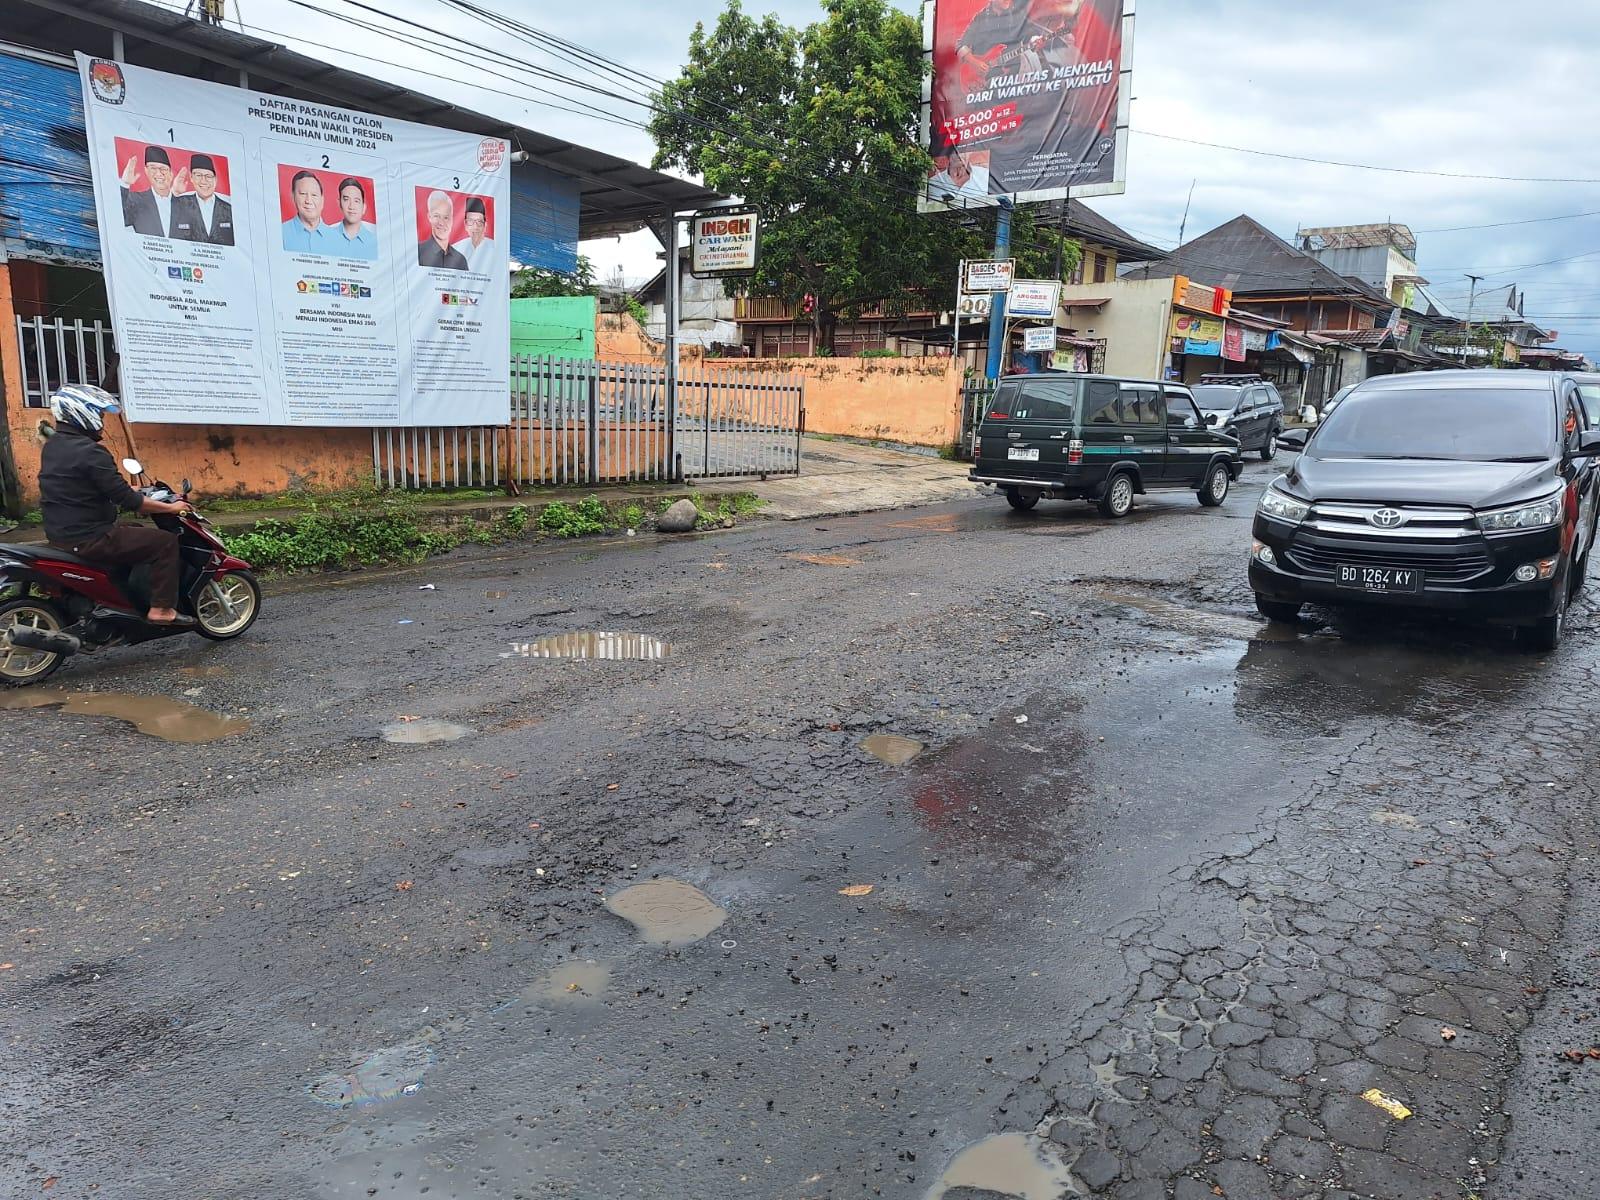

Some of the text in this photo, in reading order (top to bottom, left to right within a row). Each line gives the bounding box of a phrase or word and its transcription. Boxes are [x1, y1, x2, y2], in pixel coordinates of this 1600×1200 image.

[990, 60, 1113, 89] KUALITAS MENYALA
[966, 72, 1112, 104] DARI WAKTU KE WAKTU
[260, 98, 382, 129] DAFTAR PASANGAN CALON
[248, 108, 393, 142] PRESIDEN DAN WAKIL PRESIDEN
[167, 128, 174, 143] 1
[270, 124, 376, 150] PEMILIHAN UMUM 2024
[321, 155, 330, 169] 2
[453, 176, 460, 190] 3
[702, 218, 751, 236] INDAH
[723, 235, 752, 243] WASH
[150, 294, 182, 302] INDONESIA
[1342, 568, 1411, 585] BD 1264 KY
